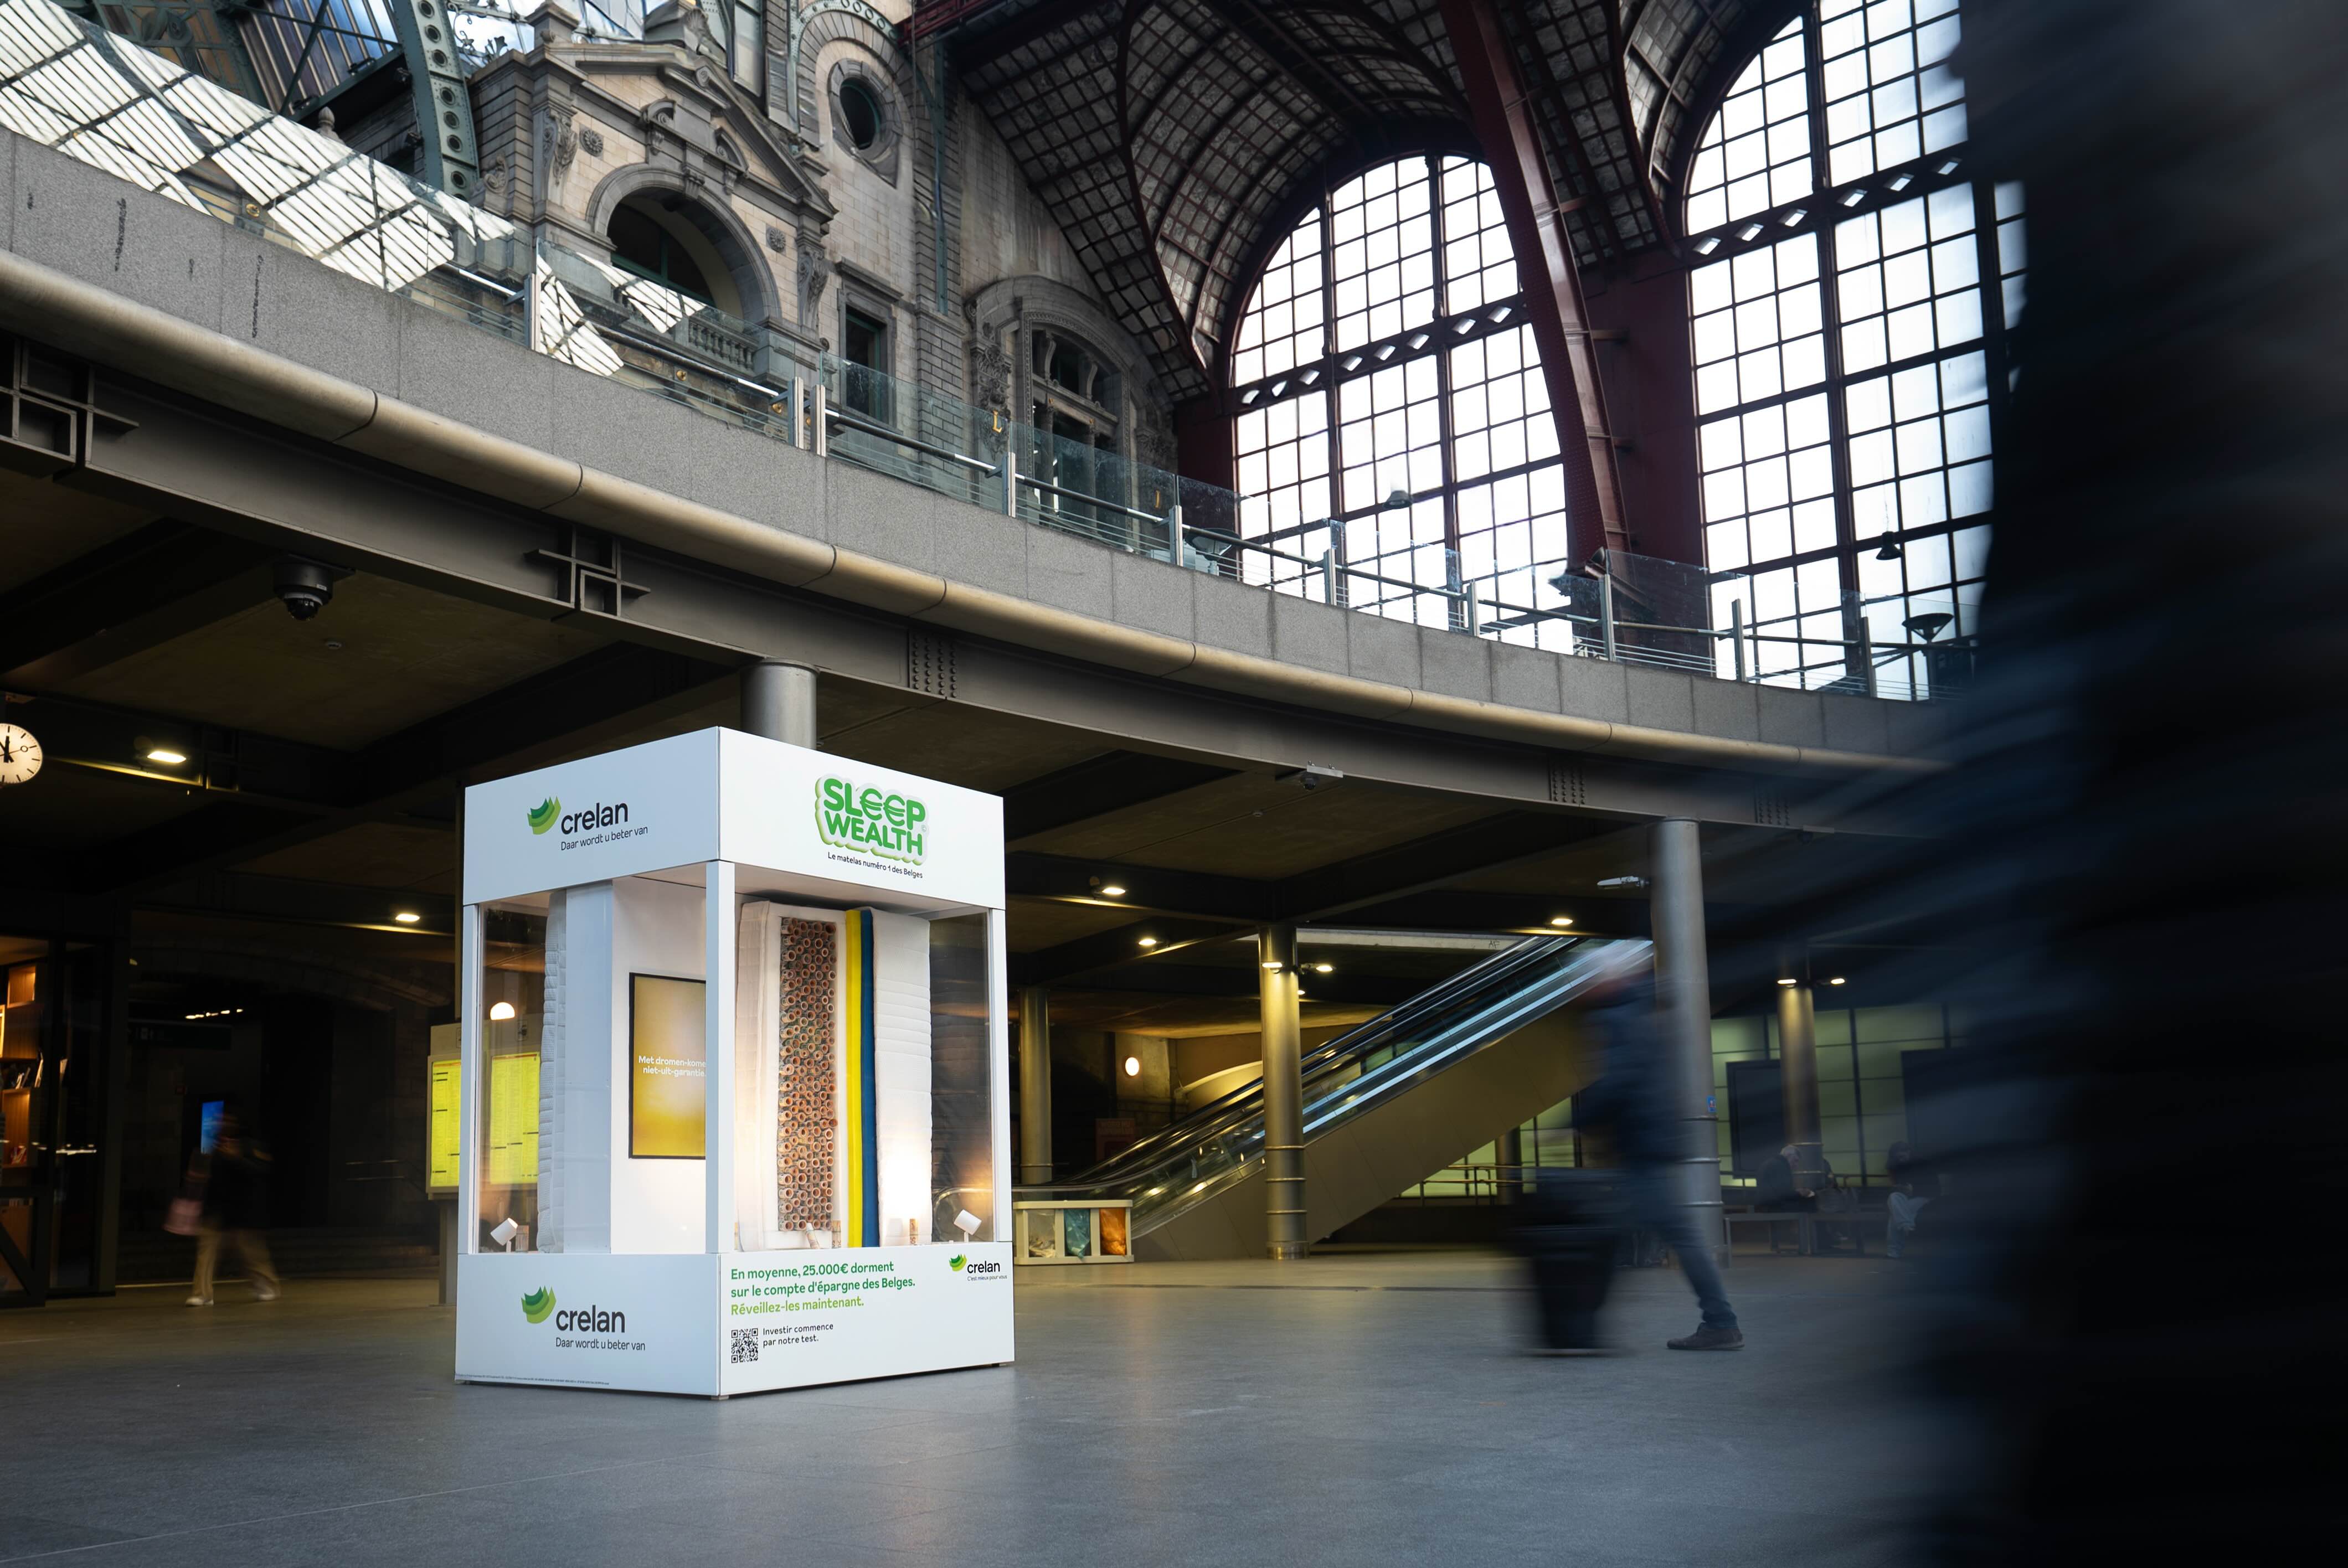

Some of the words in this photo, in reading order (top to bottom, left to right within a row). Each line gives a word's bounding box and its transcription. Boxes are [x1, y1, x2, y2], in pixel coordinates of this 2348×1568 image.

[561, 802, 629, 834] crelan
[561, 840, 579, 850] Daar
[580, 834, 603, 847] wordt
[611, 829, 632, 840] beter
[634, 827, 648, 835] van
[824, 809, 923, 856] WEALTH
[828, 852, 836, 860] Le
[837, 854, 862, 865] matelas
[863, 860, 887, 870] numéro
[904, 868, 923, 879] Belges
[639, 1055, 655, 1064] Met
[731, 1268, 745, 1280] En
[748, 1267, 801, 1281] moyenne,
[802, 1263, 849, 1276] 25.000€
[851, 1261, 894, 1273] dorment
[967, 1260, 1000, 1273] crelan
[731, 1288, 749, 1298] sur
[752, 1285, 761, 1296] le
[764, 1283, 806, 1297] compte
[807, 1281, 860, 1295] d'épargne
[862, 1278, 880, 1290] des
[882, 1276, 915, 1290] Belges.
[731, 1300, 800, 1316] Réveillez-les
[802, 1296, 864, 1310] maintenant.
[556, 1304, 626, 1333] crelan
[763, 1325, 792, 1335] Investir
[794, 1324, 833, 1333] commence
[555, 1337, 574, 1347] Daar
[575, 1338, 599, 1349] wordt
[607, 1339, 630, 1350] beter
[631, 1342, 646, 1351] van
[763, 1339, 776, 1349] par
[778, 1336, 800, 1345] notre
[801, 1334, 819, 1343] test.
